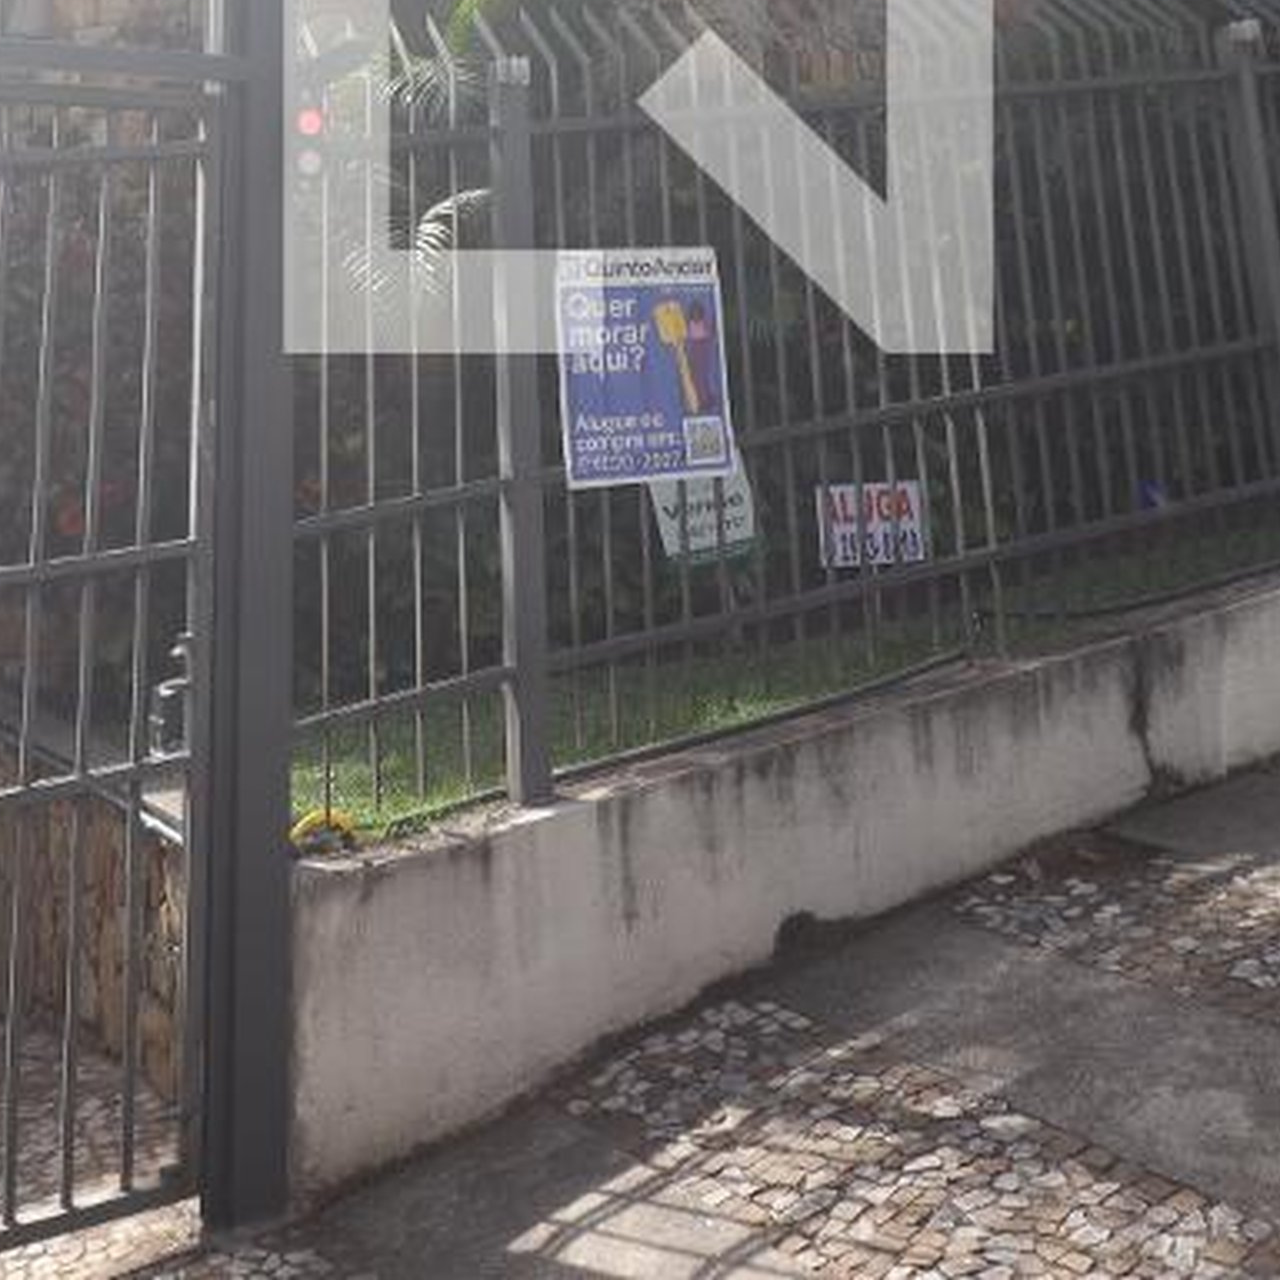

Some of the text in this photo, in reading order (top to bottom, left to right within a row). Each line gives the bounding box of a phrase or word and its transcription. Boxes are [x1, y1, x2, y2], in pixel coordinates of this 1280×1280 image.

[569, 293, 637, 319] Quer
[569, 323, 647, 348] morar
[571, 345, 645, 382] aqui?
